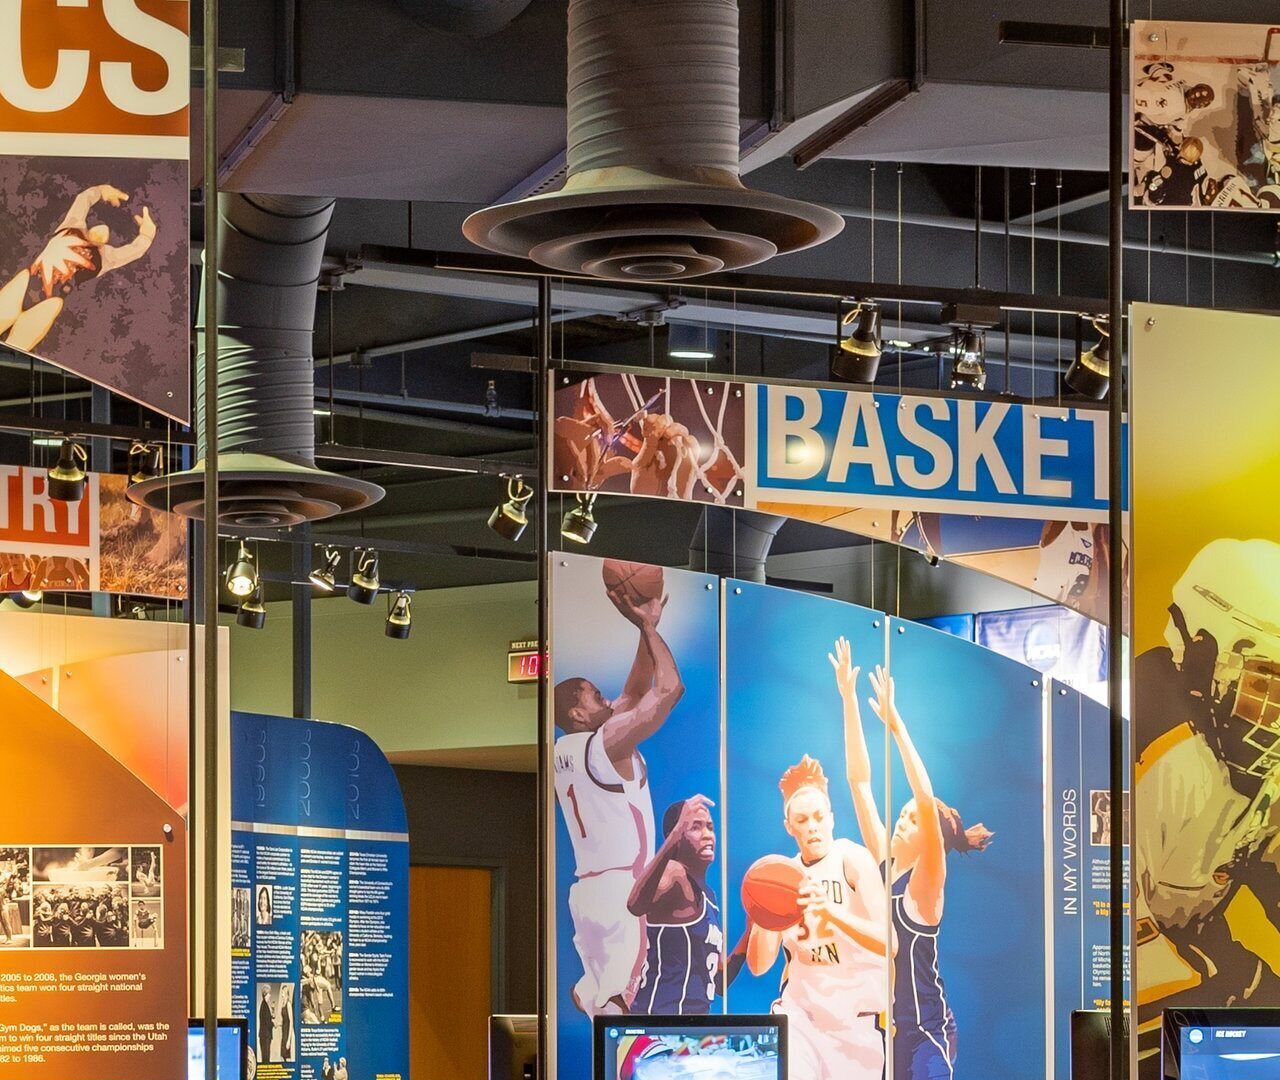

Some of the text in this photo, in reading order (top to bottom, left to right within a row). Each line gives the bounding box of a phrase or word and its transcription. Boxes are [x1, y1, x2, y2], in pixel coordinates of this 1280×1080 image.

[512, 641, 526, 649] NEXT
[1062, 789, 1078, 915] IN MY WORDS
[1, 973, 21, 982] 2005
[24, 973, 32, 982] to
[34, 973, 56, 984] 2008,
[60, 973, 72, 982] the
[75, 973, 107, 985] Georgia
[109, 973, 146, 983] women's
[17, 983, 37, 993] team
[40, 985, 57, 993] won
[59, 983, 74, 992] four
[78, 982, 108, 995] straight
[111, 982, 142, 992] national
